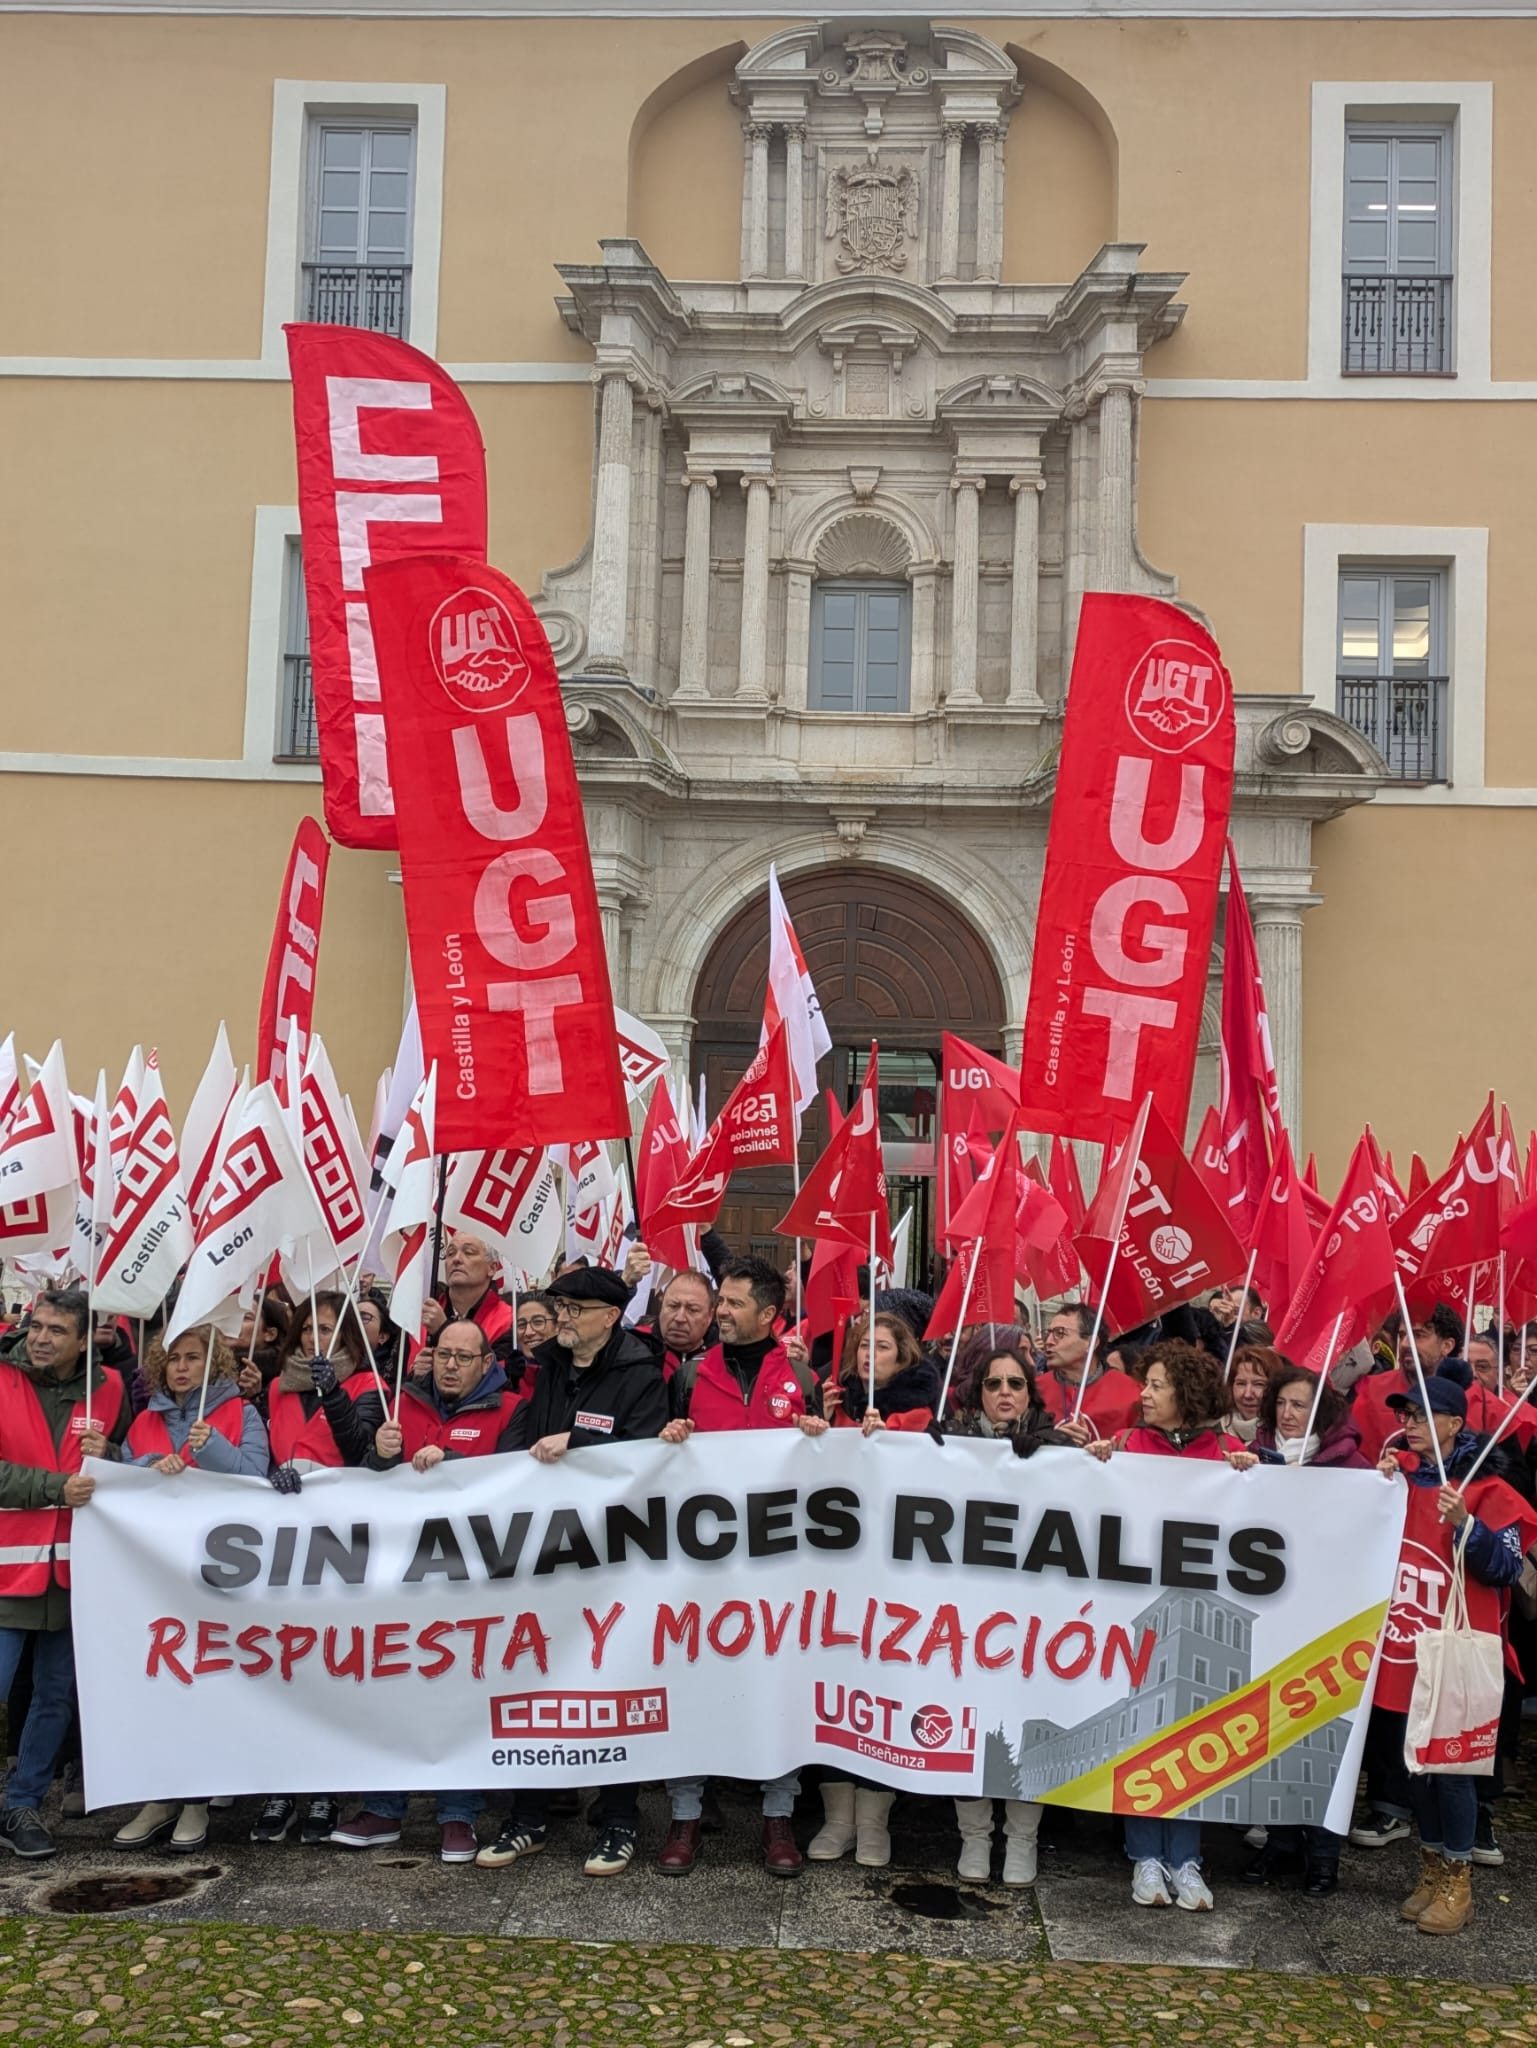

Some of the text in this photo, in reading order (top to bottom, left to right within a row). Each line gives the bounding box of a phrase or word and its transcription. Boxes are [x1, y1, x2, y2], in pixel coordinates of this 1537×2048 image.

[441, 607, 513, 662] UGT
[1141, 658, 1213, 707] UGT
[451, 712, 583, 1096] UGT
[1082, 755, 1205, 1101] UGT
[446, 933, 476, 1100] Castilla y León
[1044, 934, 1076, 1086] Castilla y León
[519, 1171, 553, 1234] Castilla
[121, 1204, 181, 1285] Castilla y
[207, 1226, 254, 1266] León
[1132, 1255, 1165, 1300] León
[771, 1397, 790, 1409] UGT
[201, 1487, 1287, 1596] SIN AVANCES REALES
[1392, 1561, 1446, 1617] GT
[146, 1589, 1157, 1689] RESPUESTA Y MOVILIZACIÓN
[500, 1699, 618, 1729] CCOO
[815, 1681, 903, 1741] UGT
[1123, 1628, 1382, 1812] STOP STO
[491, 1744, 627, 1766] enseñanza
[857, 1738, 926, 1769] Enseñanza
